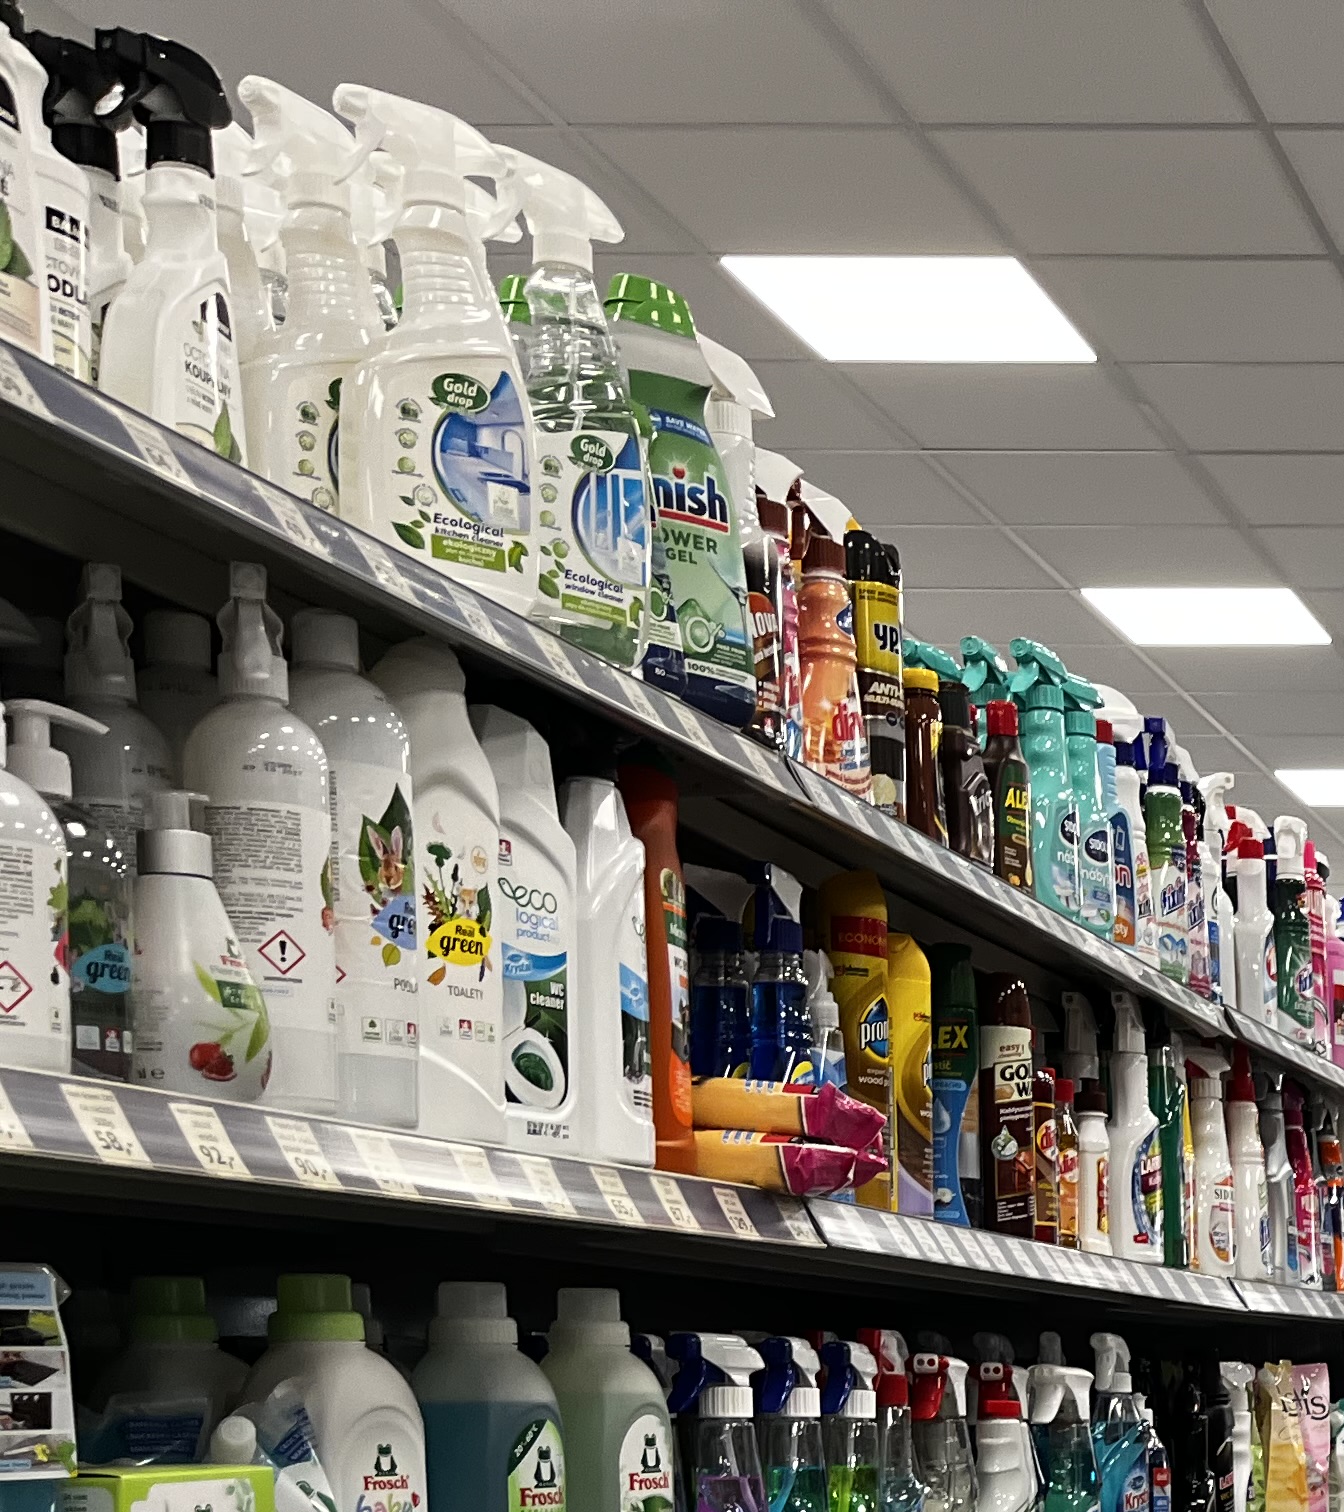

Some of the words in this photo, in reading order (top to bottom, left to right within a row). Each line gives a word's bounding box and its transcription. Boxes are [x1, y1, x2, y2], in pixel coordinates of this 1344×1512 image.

[443, 377, 479, 398] Gold
[446, 391, 474, 410] drop
[579, 439, 607, 457] Gold
[583, 452, 604, 468] drop
[433, 513, 505, 539] Ecological
[665, 547, 698, 565] GEL
[564, 569, 624, 594] Ecological
[515, 908, 560, 931] logical
[455, 925, 476, 937] Real
[439, 935, 484, 957] green
[550, 981, 565, 998] WC
[530, 991, 566, 1010] cleaner
[363, 1475, 410, 1491] Frosch
[629, 1472, 669, 1492] Frosch
